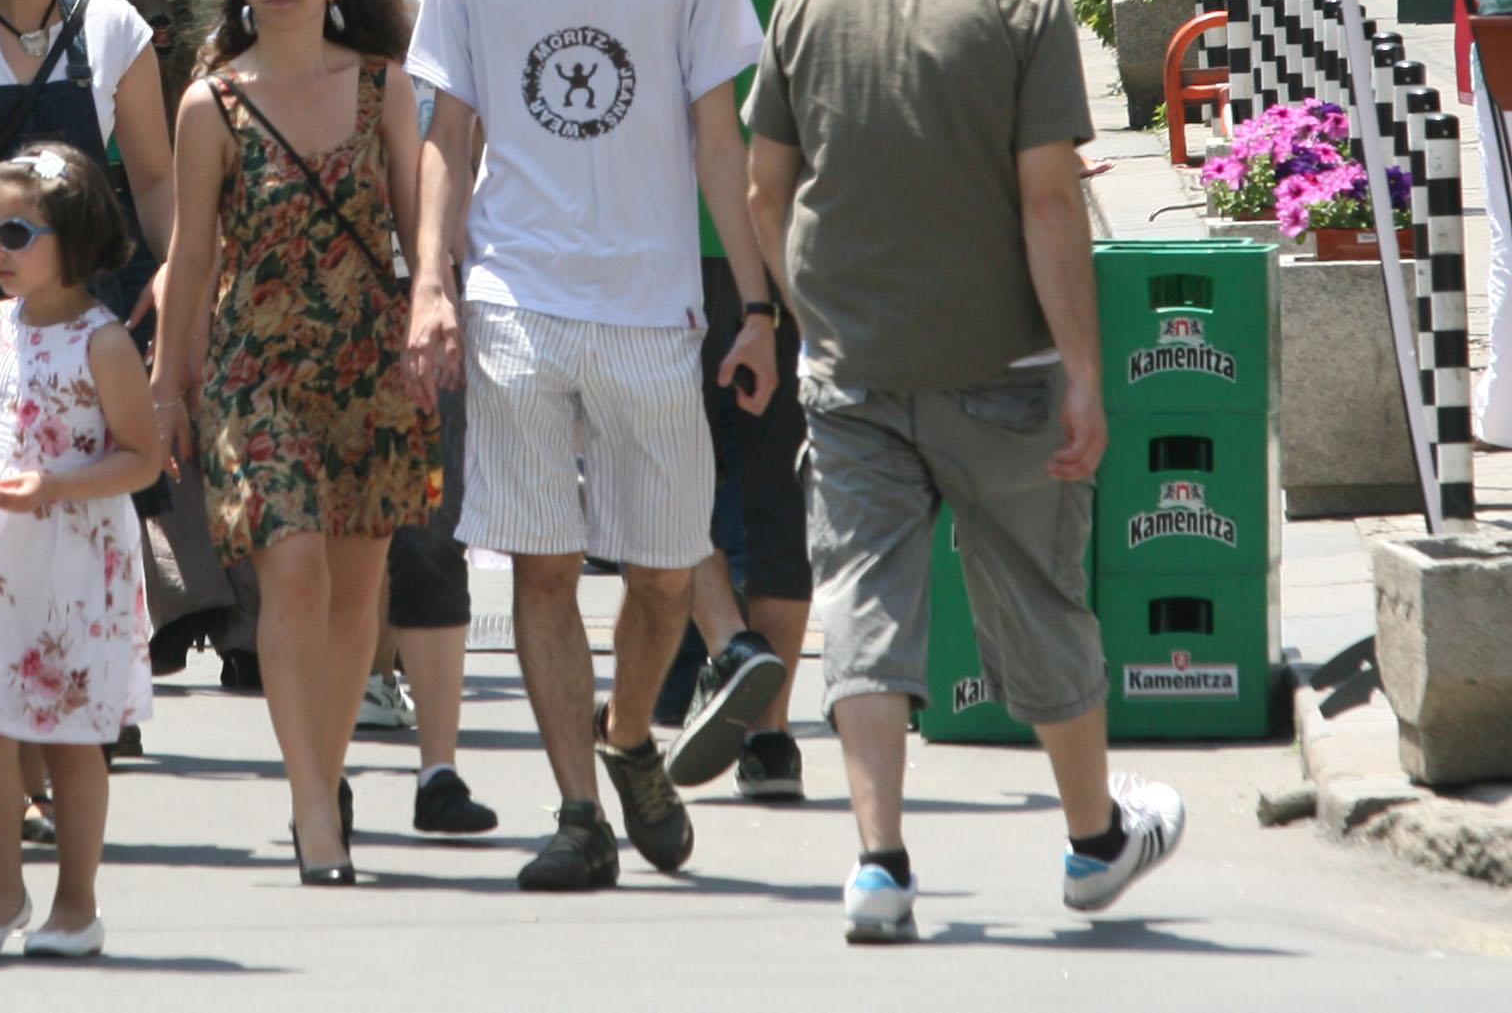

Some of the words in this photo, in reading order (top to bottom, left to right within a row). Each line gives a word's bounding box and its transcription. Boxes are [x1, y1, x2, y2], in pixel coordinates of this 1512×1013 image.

[533, 30, 609, 61] MORITZ
[529, 98, 579, 138] WEAR
[1130, 343, 1235, 381] Kamenitza
[1130, 507, 1235, 547] Kamenitza
[1129, 671, 1233, 690] Kamenitza
